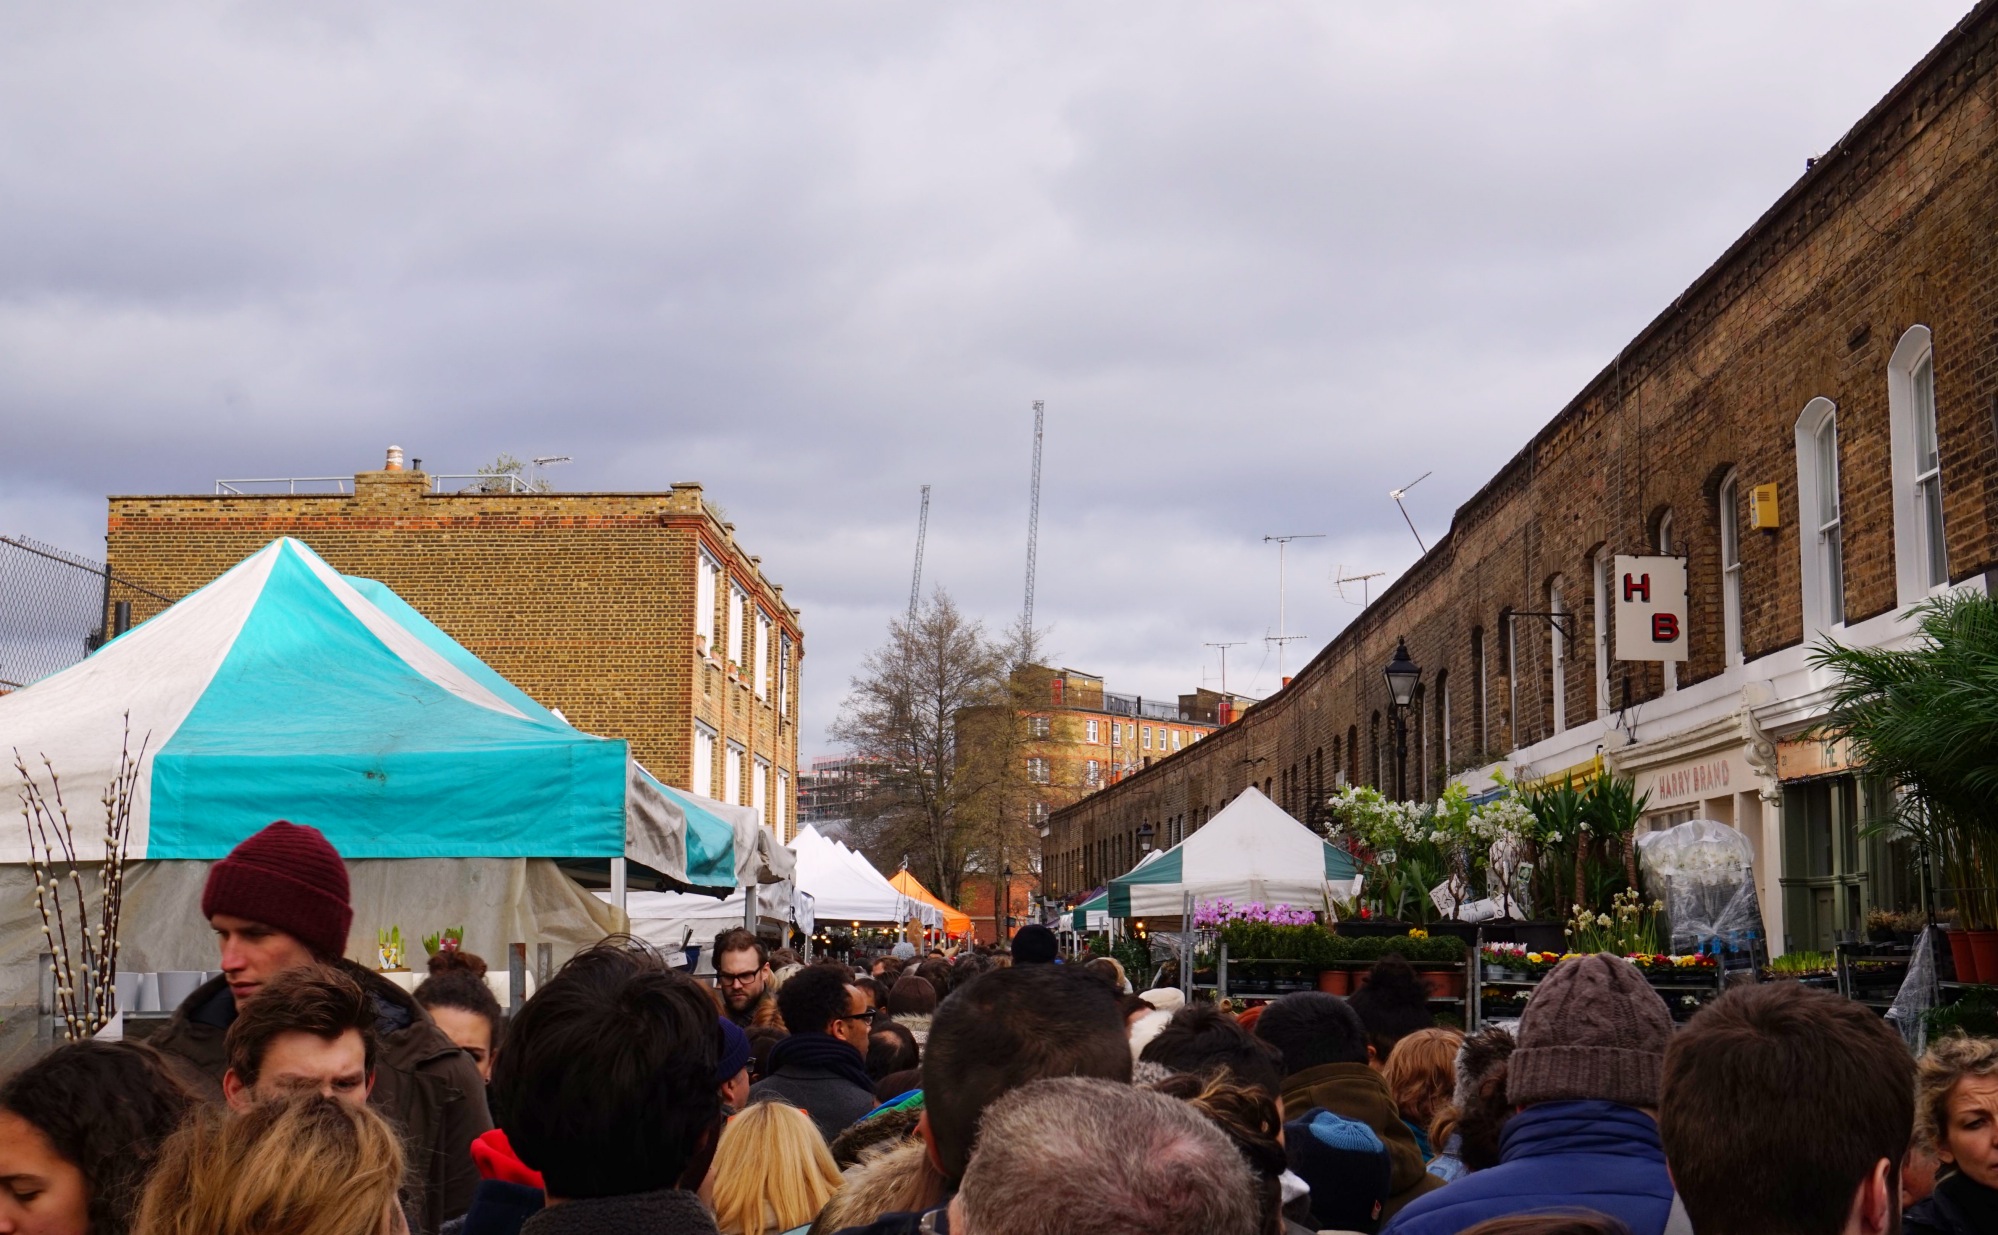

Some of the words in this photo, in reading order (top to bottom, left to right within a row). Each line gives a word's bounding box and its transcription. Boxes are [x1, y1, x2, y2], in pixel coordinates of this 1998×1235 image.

[1624, 573, 1650, 602] H
[1652, 613, 1679, 642] B
[1659, 769, 1690, 799] HARRY
[1693, 759, 1730, 791] BRAND
